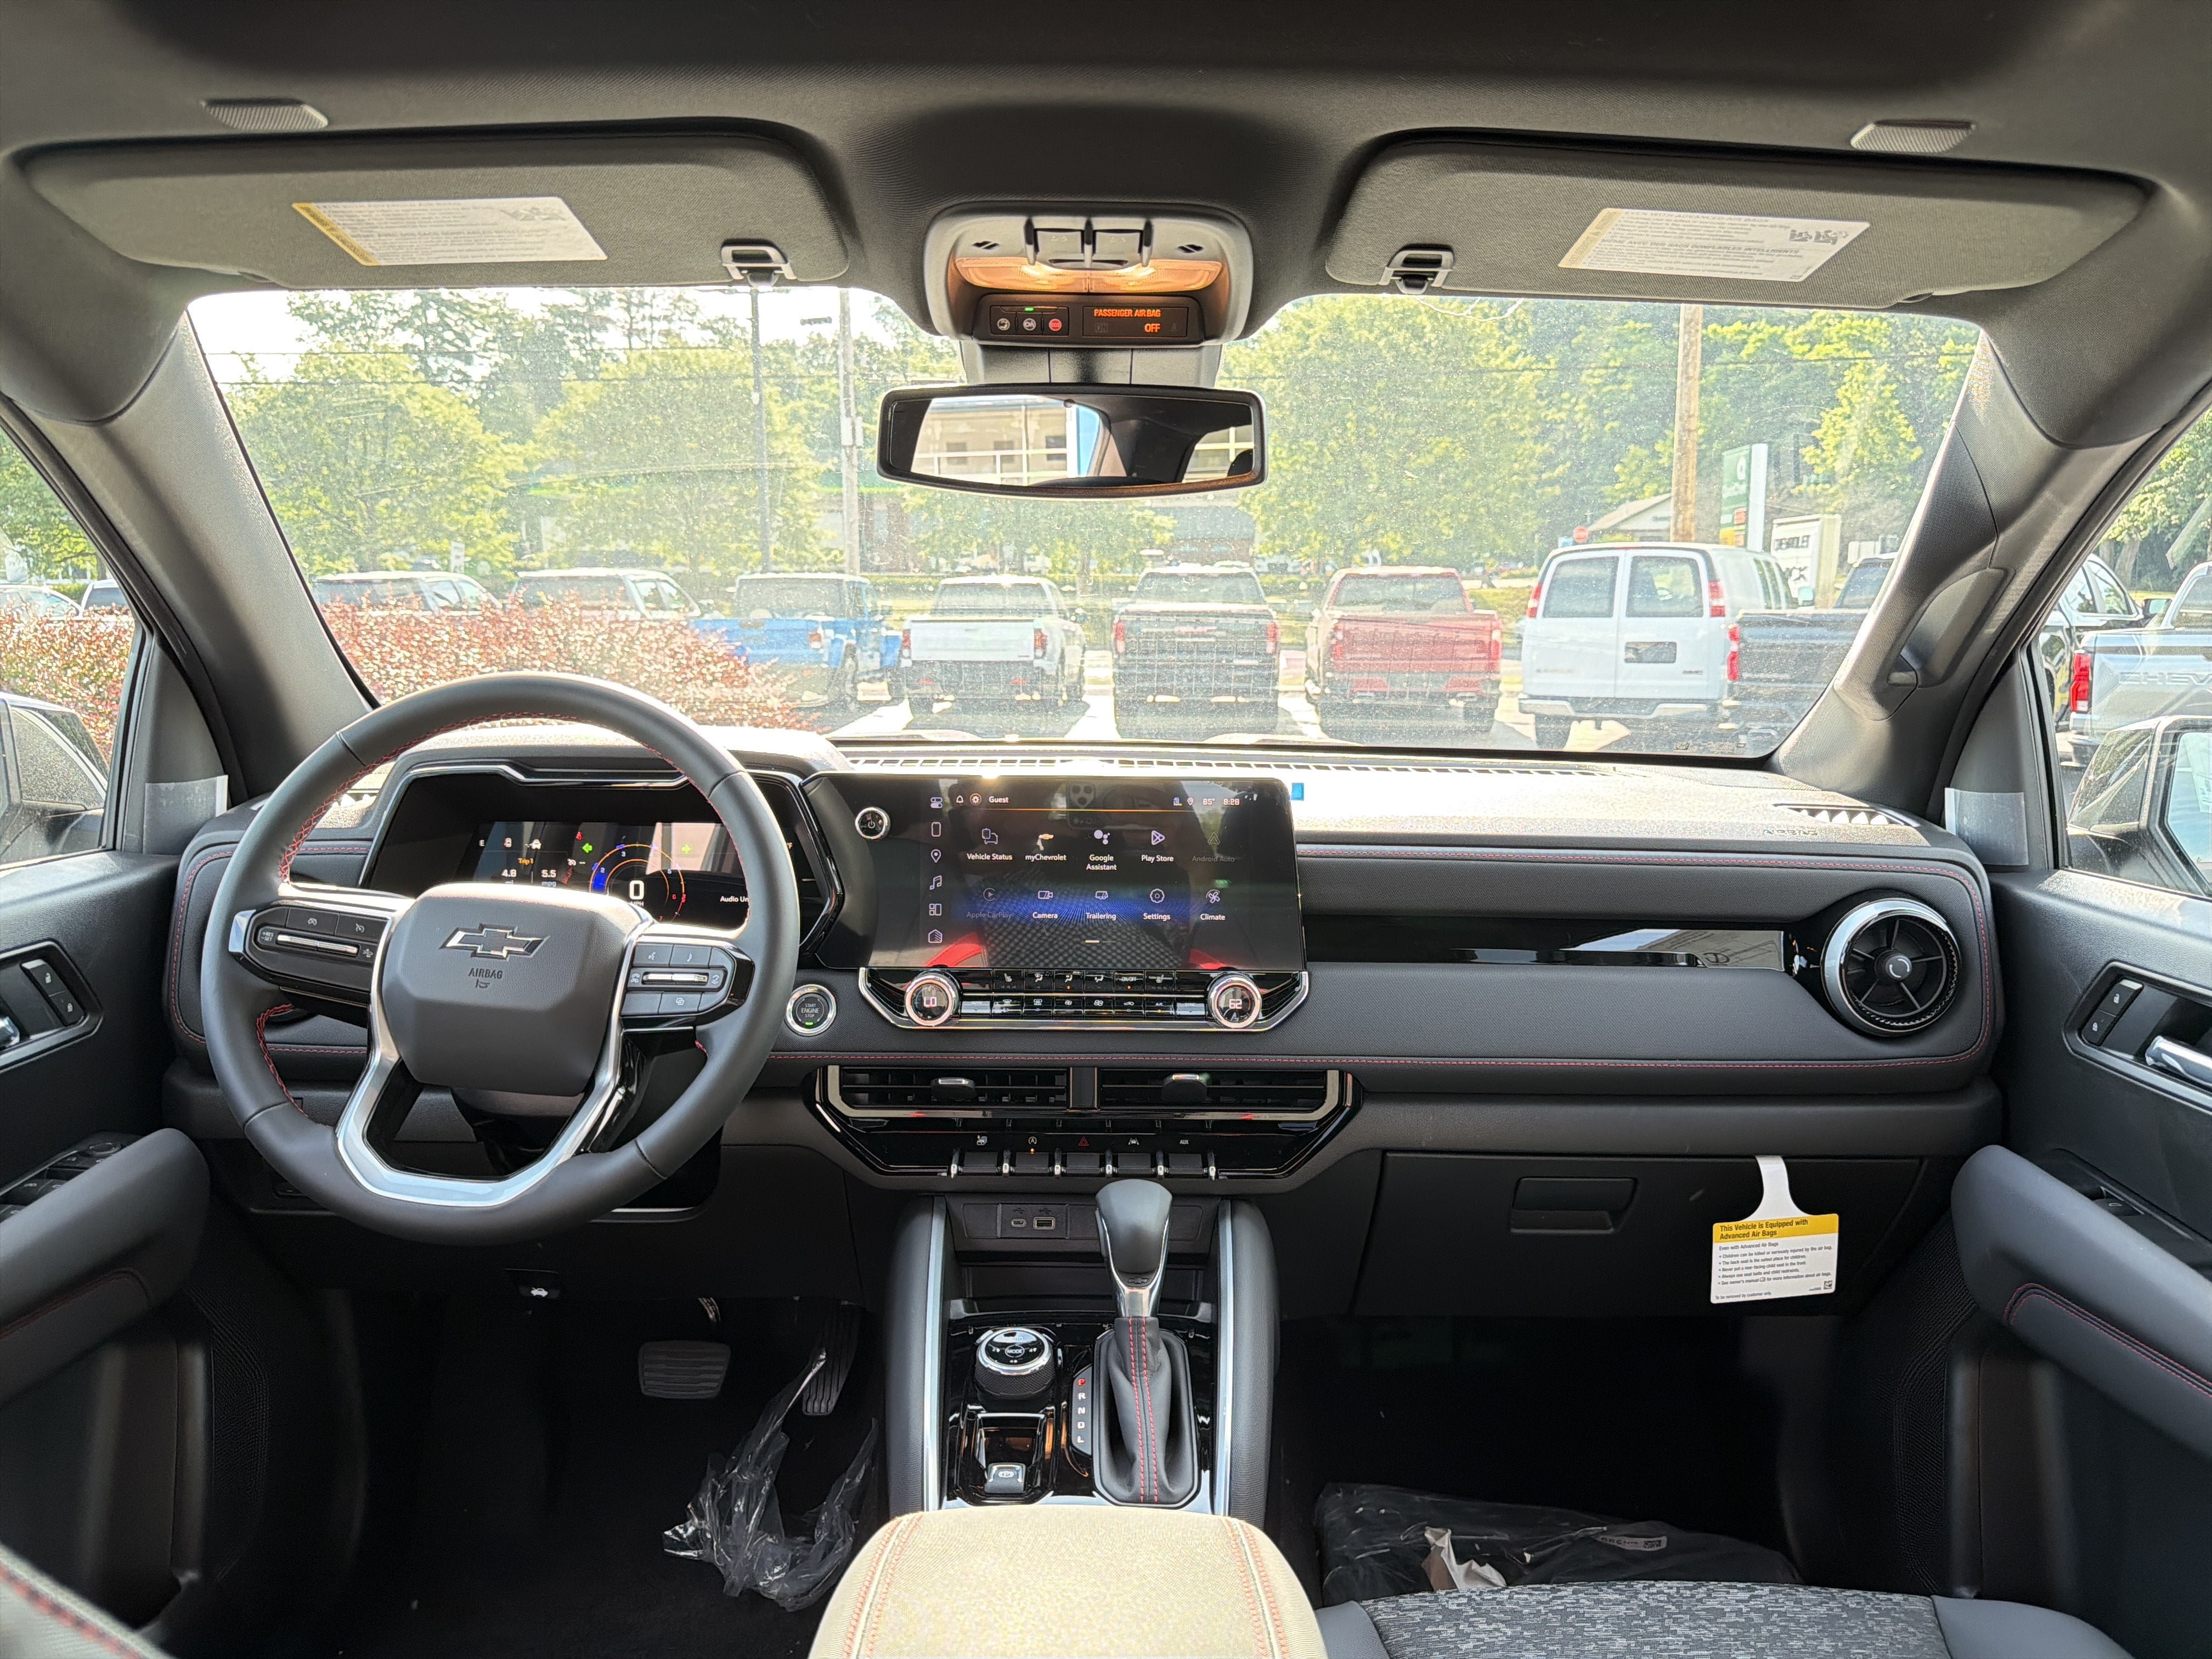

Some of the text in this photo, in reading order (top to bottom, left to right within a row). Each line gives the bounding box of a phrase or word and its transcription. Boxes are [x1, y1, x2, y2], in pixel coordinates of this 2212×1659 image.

[1094, 309, 1133, 317] PASSENGER
[1144, 323, 1161, 332] OFF
[517, 857, 530, 866] Trip
[1089, 854, 1114, 863] Google
[1141, 855, 1155, 864] Play
[501, 869, 517, 877] 4.8
[541, 869, 557, 878] 5.5
[629, 880, 645, 900] 0
[1085, 912, 1116, 921] Trailering
[1143, 913, 1171, 921] Settings
[468, 968, 503, 979] AIRBAG
[1765, 1220, 1793, 1229] Equipped
[1719, 1232, 1750, 1240] Advanced
[1762, 1229, 1778, 1238] Bags
[1077, 1378, 1086, 1386] P
[1077, 1435, 1085, 1443] L
